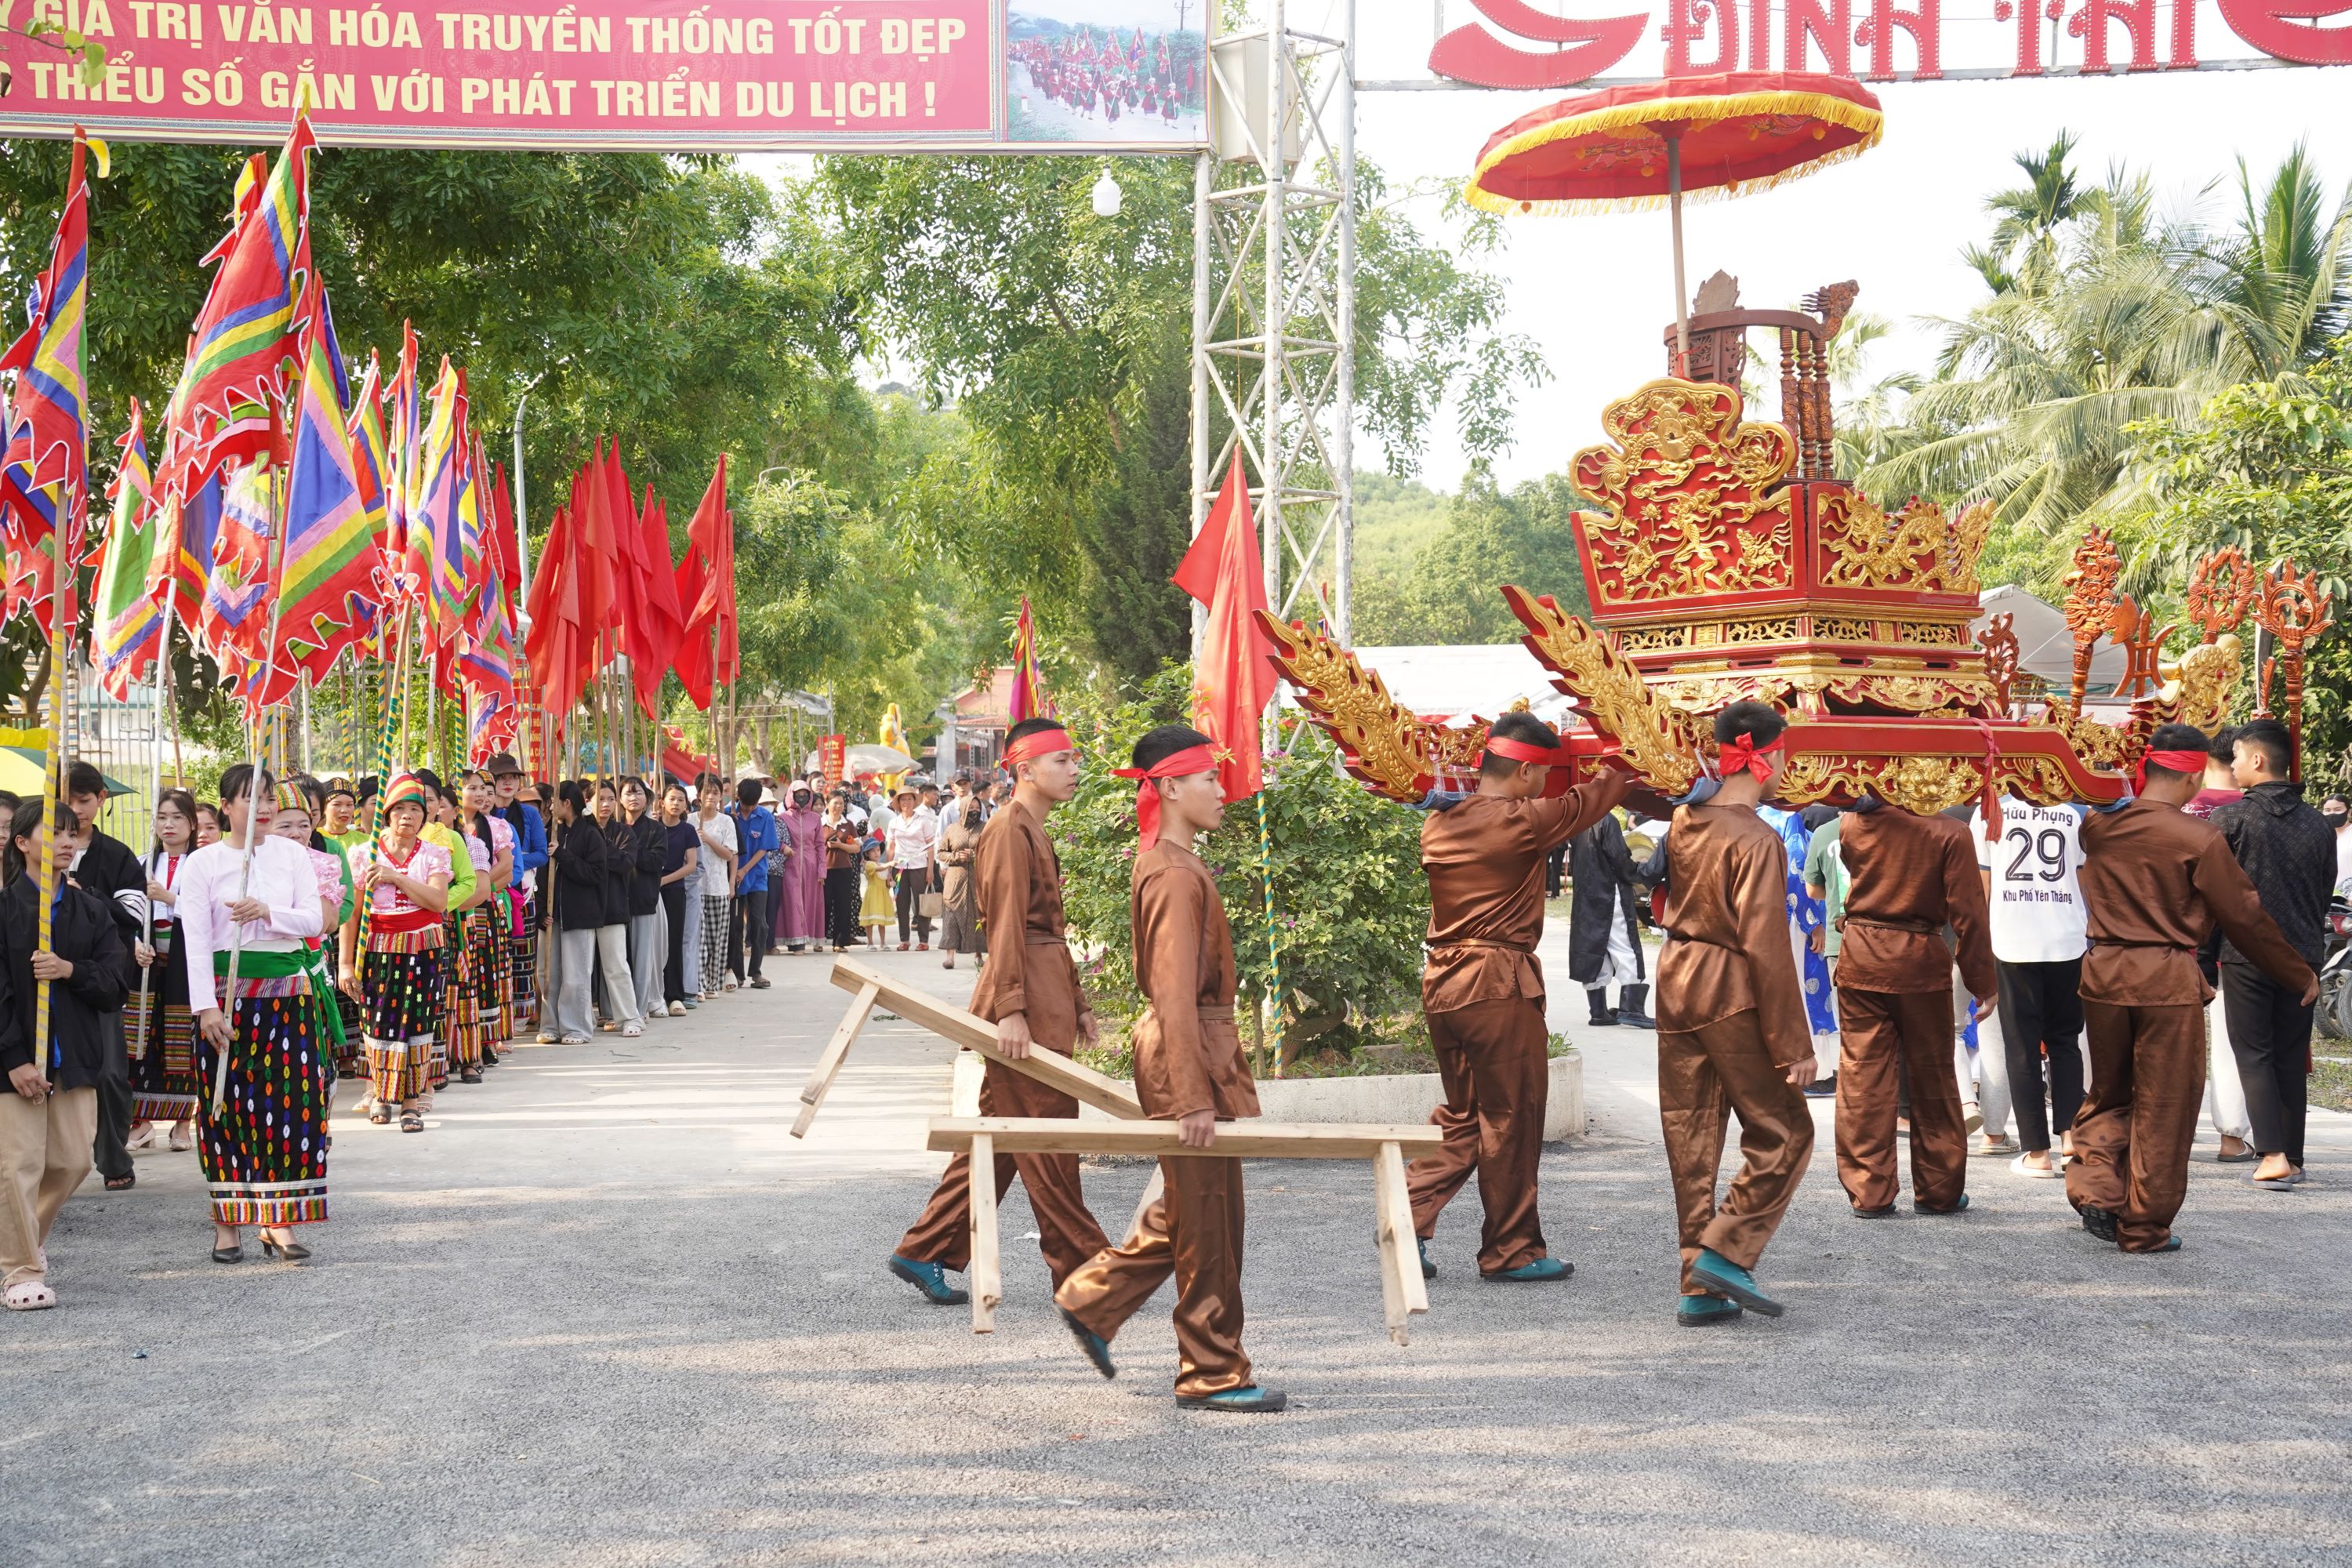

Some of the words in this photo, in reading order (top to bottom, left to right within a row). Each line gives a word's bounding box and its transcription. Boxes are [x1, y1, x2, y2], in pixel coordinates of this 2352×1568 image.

[129, 2, 202, 49] TRỊ
[217, 0, 313, 45] VĂN
[329, 2, 423, 49] HÓA
[436, 4, 611, 53] TRUYỀN
[626, 5, 774, 54] THỐNG
[788, 5, 866, 55] TỐT
[880, 18, 966, 62] ĐẸP
[182, 56, 244, 107] SỐ
[260, 58, 356, 111] GẮN
[371, 68, 444, 113] VỚI
[461, 71, 577, 116] PHÁT
[590, 66, 720, 117] TRIỂN
[736, 81, 794, 118] DU
[810, 82, 906, 125] LỊCH
[924, 81, 935, 117] !
[2032, 808, 2073, 827] Phụng
[2005, 827, 2065, 882] 29
[2003, 890, 2017, 902] Khu
[2019, 887, 2033, 902] Phố
[2034, 889, 2049, 902] Yên
[2051, 887, 2072, 904] Thắng
